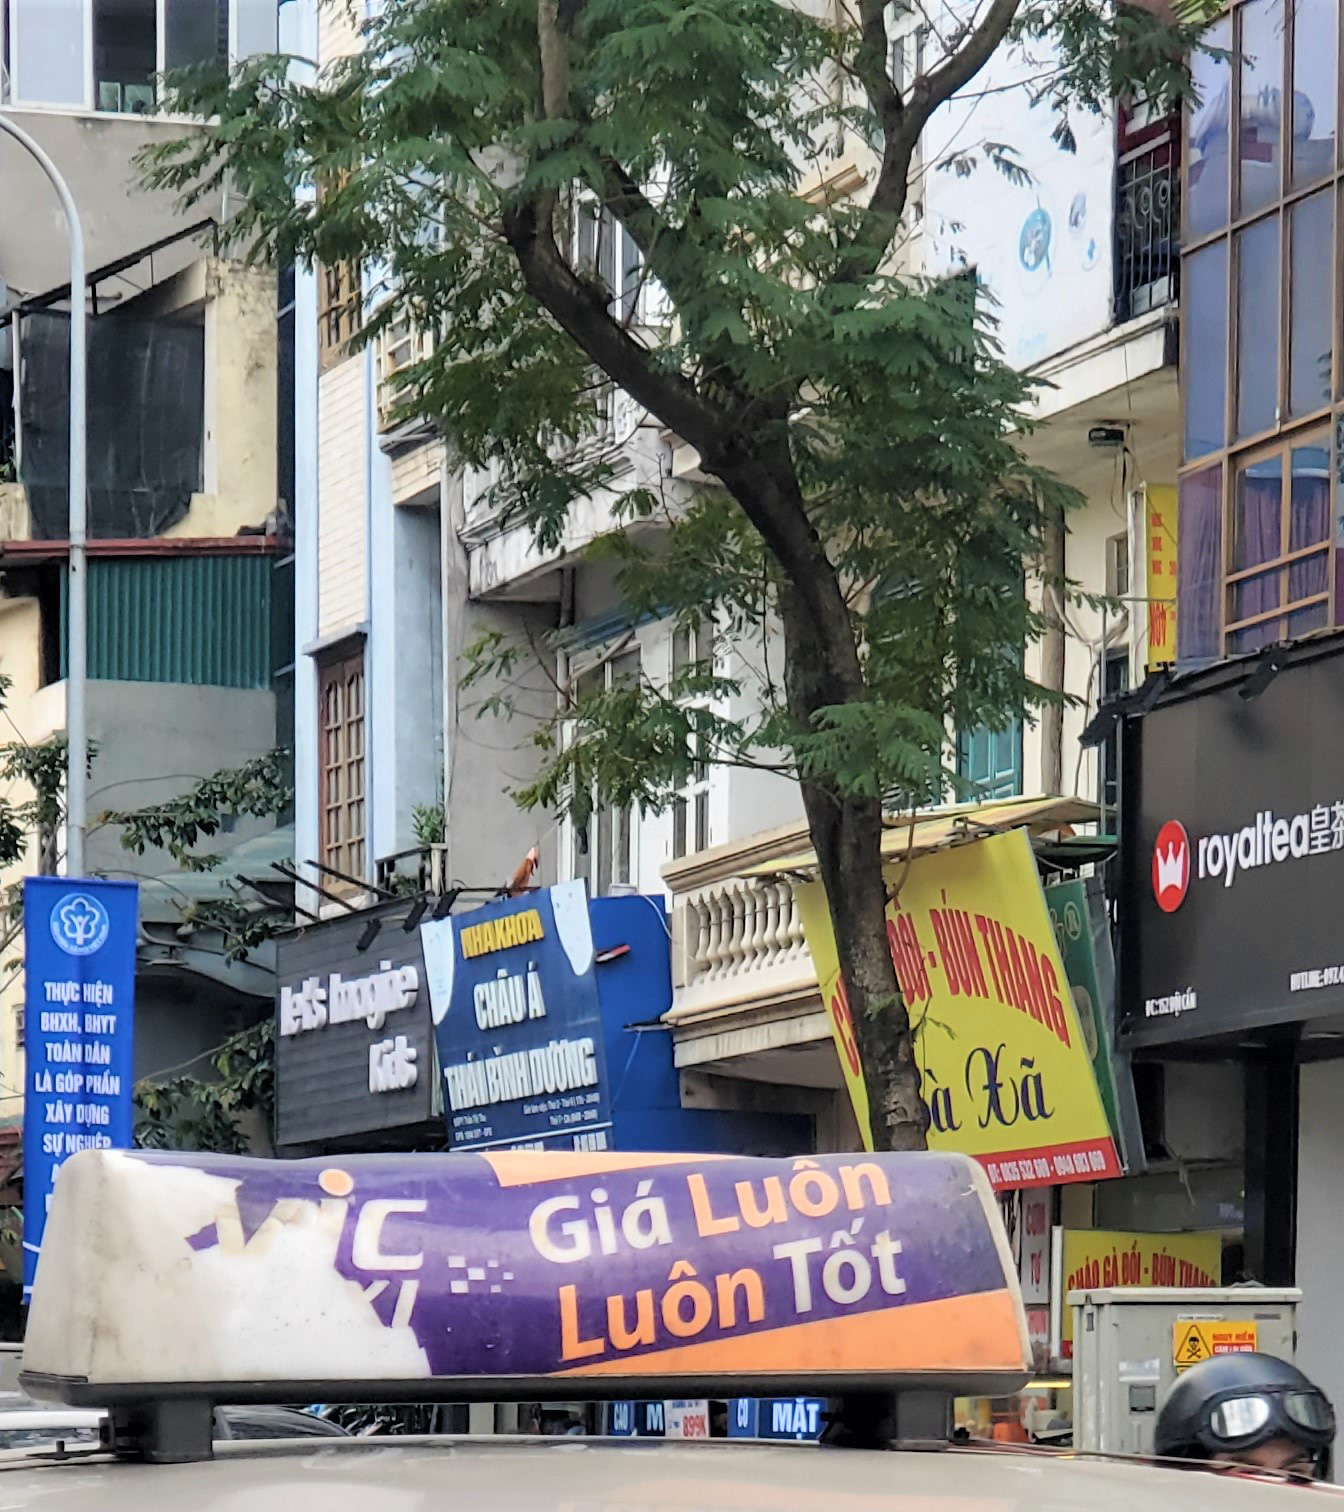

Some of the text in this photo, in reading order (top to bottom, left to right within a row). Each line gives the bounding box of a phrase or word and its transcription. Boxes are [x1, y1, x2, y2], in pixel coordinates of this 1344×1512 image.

[1198, 810, 1309, 888] royaltea
[44, 978, 113, 1009] THỰC HIỆN
[473, 960, 547, 1031] CHÂU Á
[929, 888, 990, 998] BÚN
[974, 913, 1072, 1050] THANG
[41, 1012, 117, 1036] BHXH, BHYT
[45, 1041, 111, 1066] TOÀN DÂN
[444, 1052, 490, 1112] THÁI
[486, 1045, 533, 1102] BÌNH
[35, 1069, 53, 1094] LÀ
[55, 1069, 84, 1095] GÓP
[45, 1100, 110, 1129] XÂY DỰNG
[528, 1160, 891, 1265] Giá Luôn
[559, 1217, 906, 1363] Luôn Tốt
[1152, 1246, 1176, 1287] BÚN
